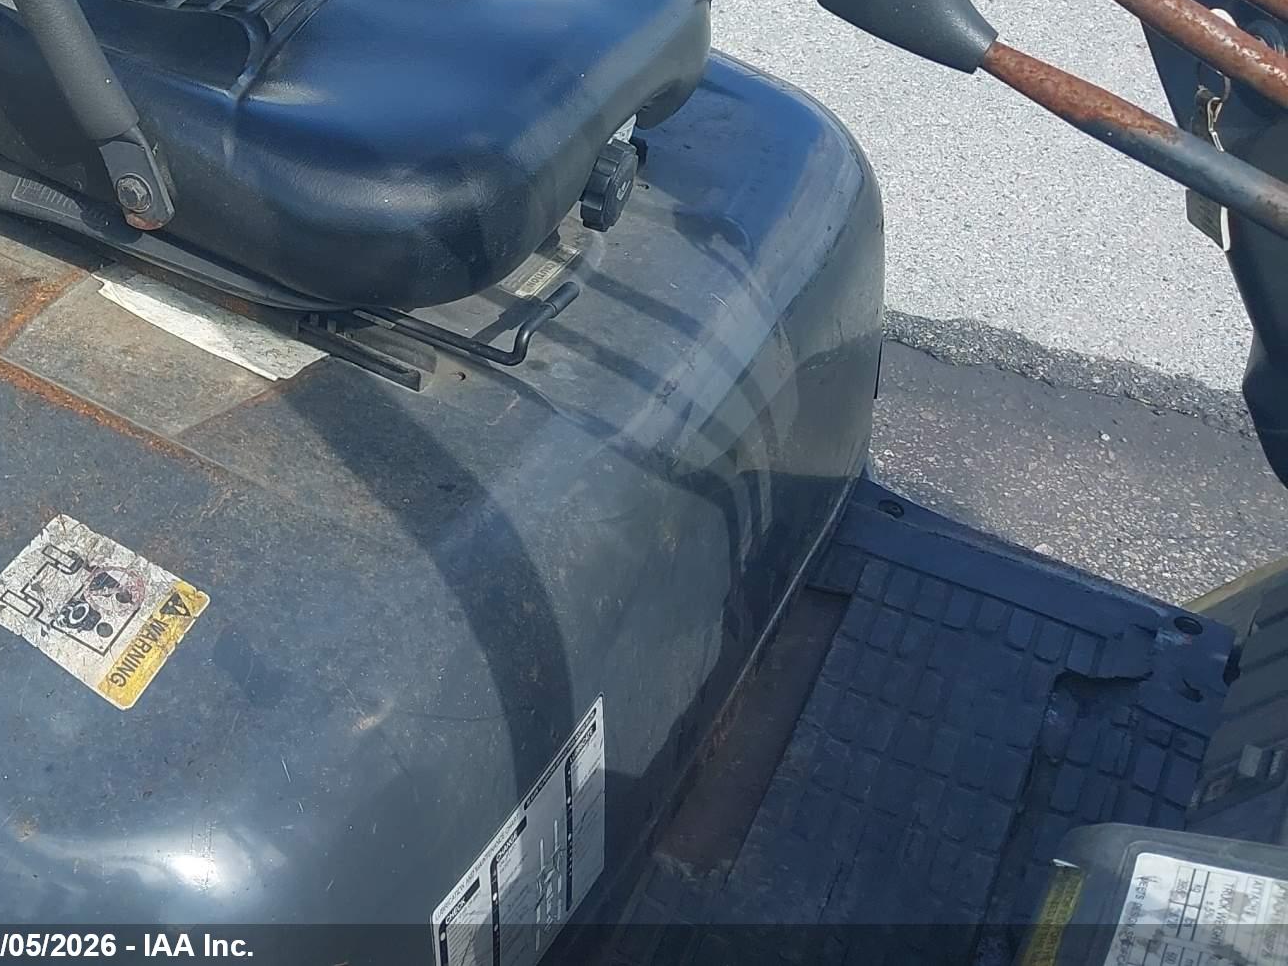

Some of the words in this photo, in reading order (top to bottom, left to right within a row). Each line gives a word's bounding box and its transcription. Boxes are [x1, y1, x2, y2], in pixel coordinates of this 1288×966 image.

[109, 618, 169, 687] WARNING
[495, 830, 518, 862] CHANGE
[445, 897, 466, 924] CHECK
[1218, 882, 1234, 911] TRUCK
